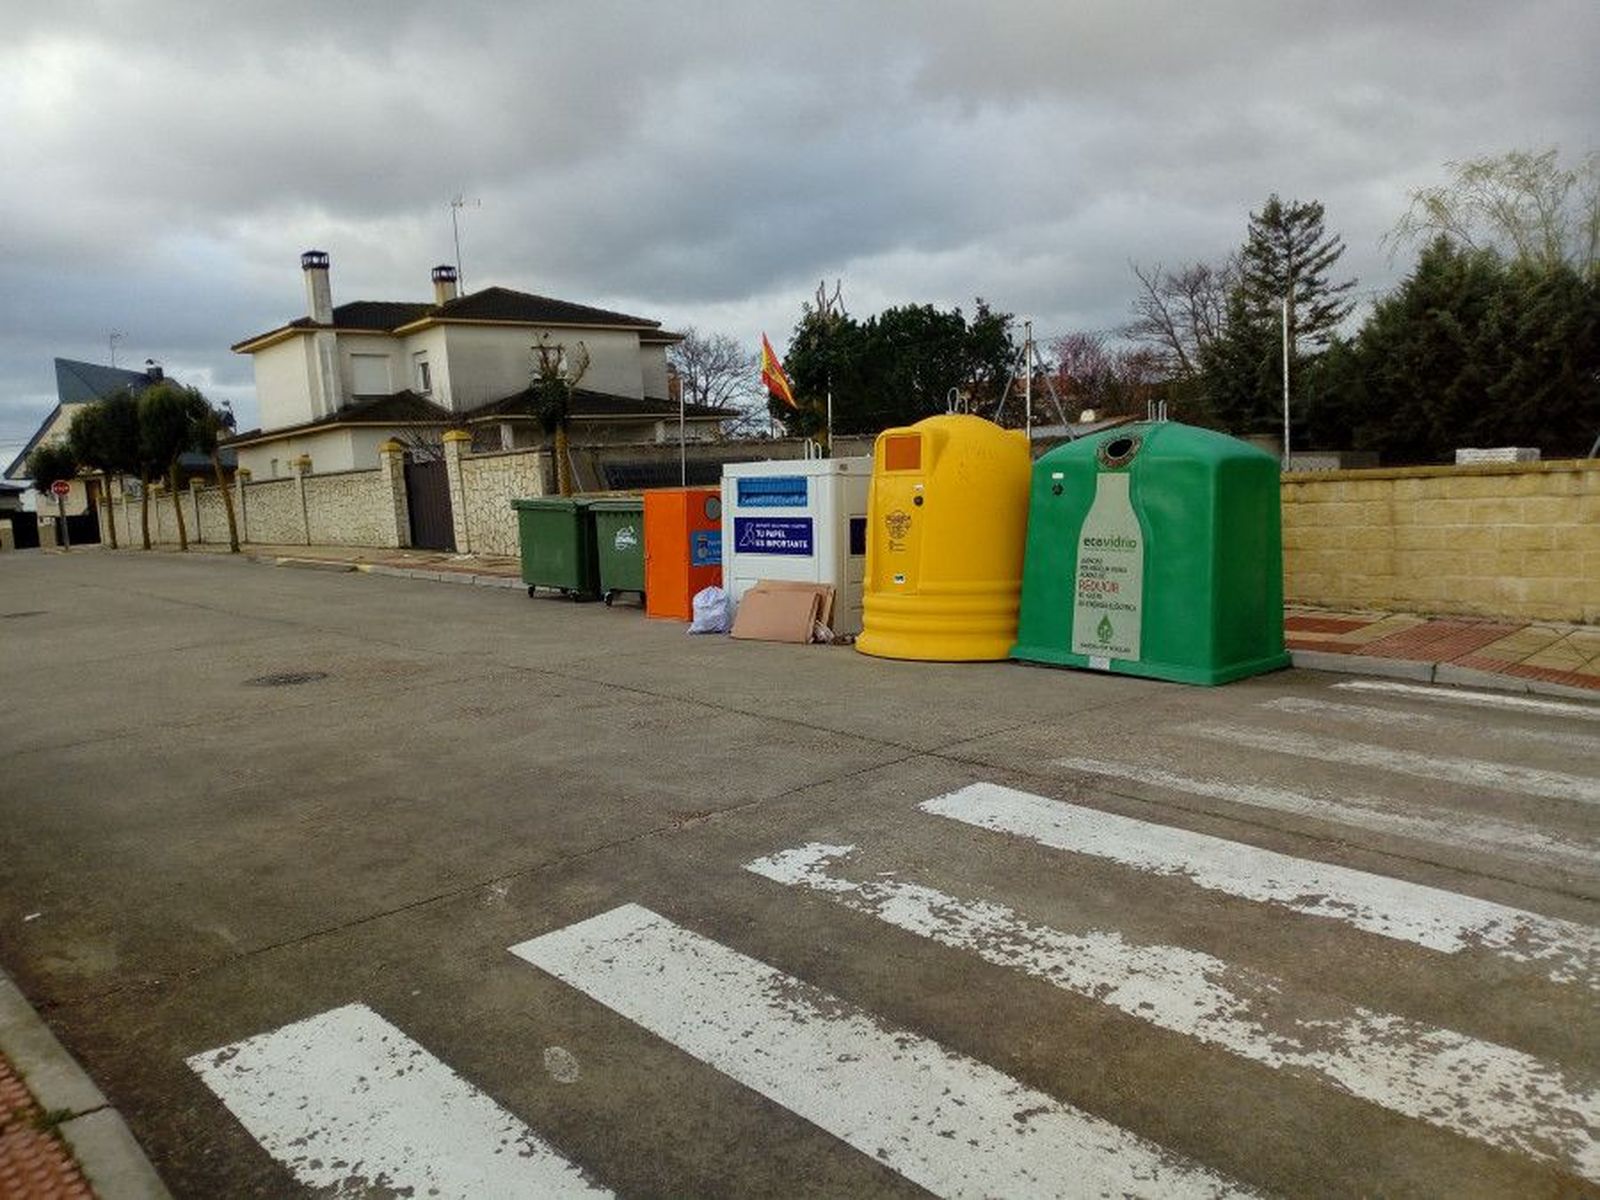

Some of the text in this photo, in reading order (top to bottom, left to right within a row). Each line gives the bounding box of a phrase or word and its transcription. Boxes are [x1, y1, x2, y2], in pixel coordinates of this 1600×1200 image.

[755, 529, 786, 538] TU PAPEL
[766, 540, 808, 548] IMPORTANTE
[1083, 535, 1137, 548] ecovidrio
